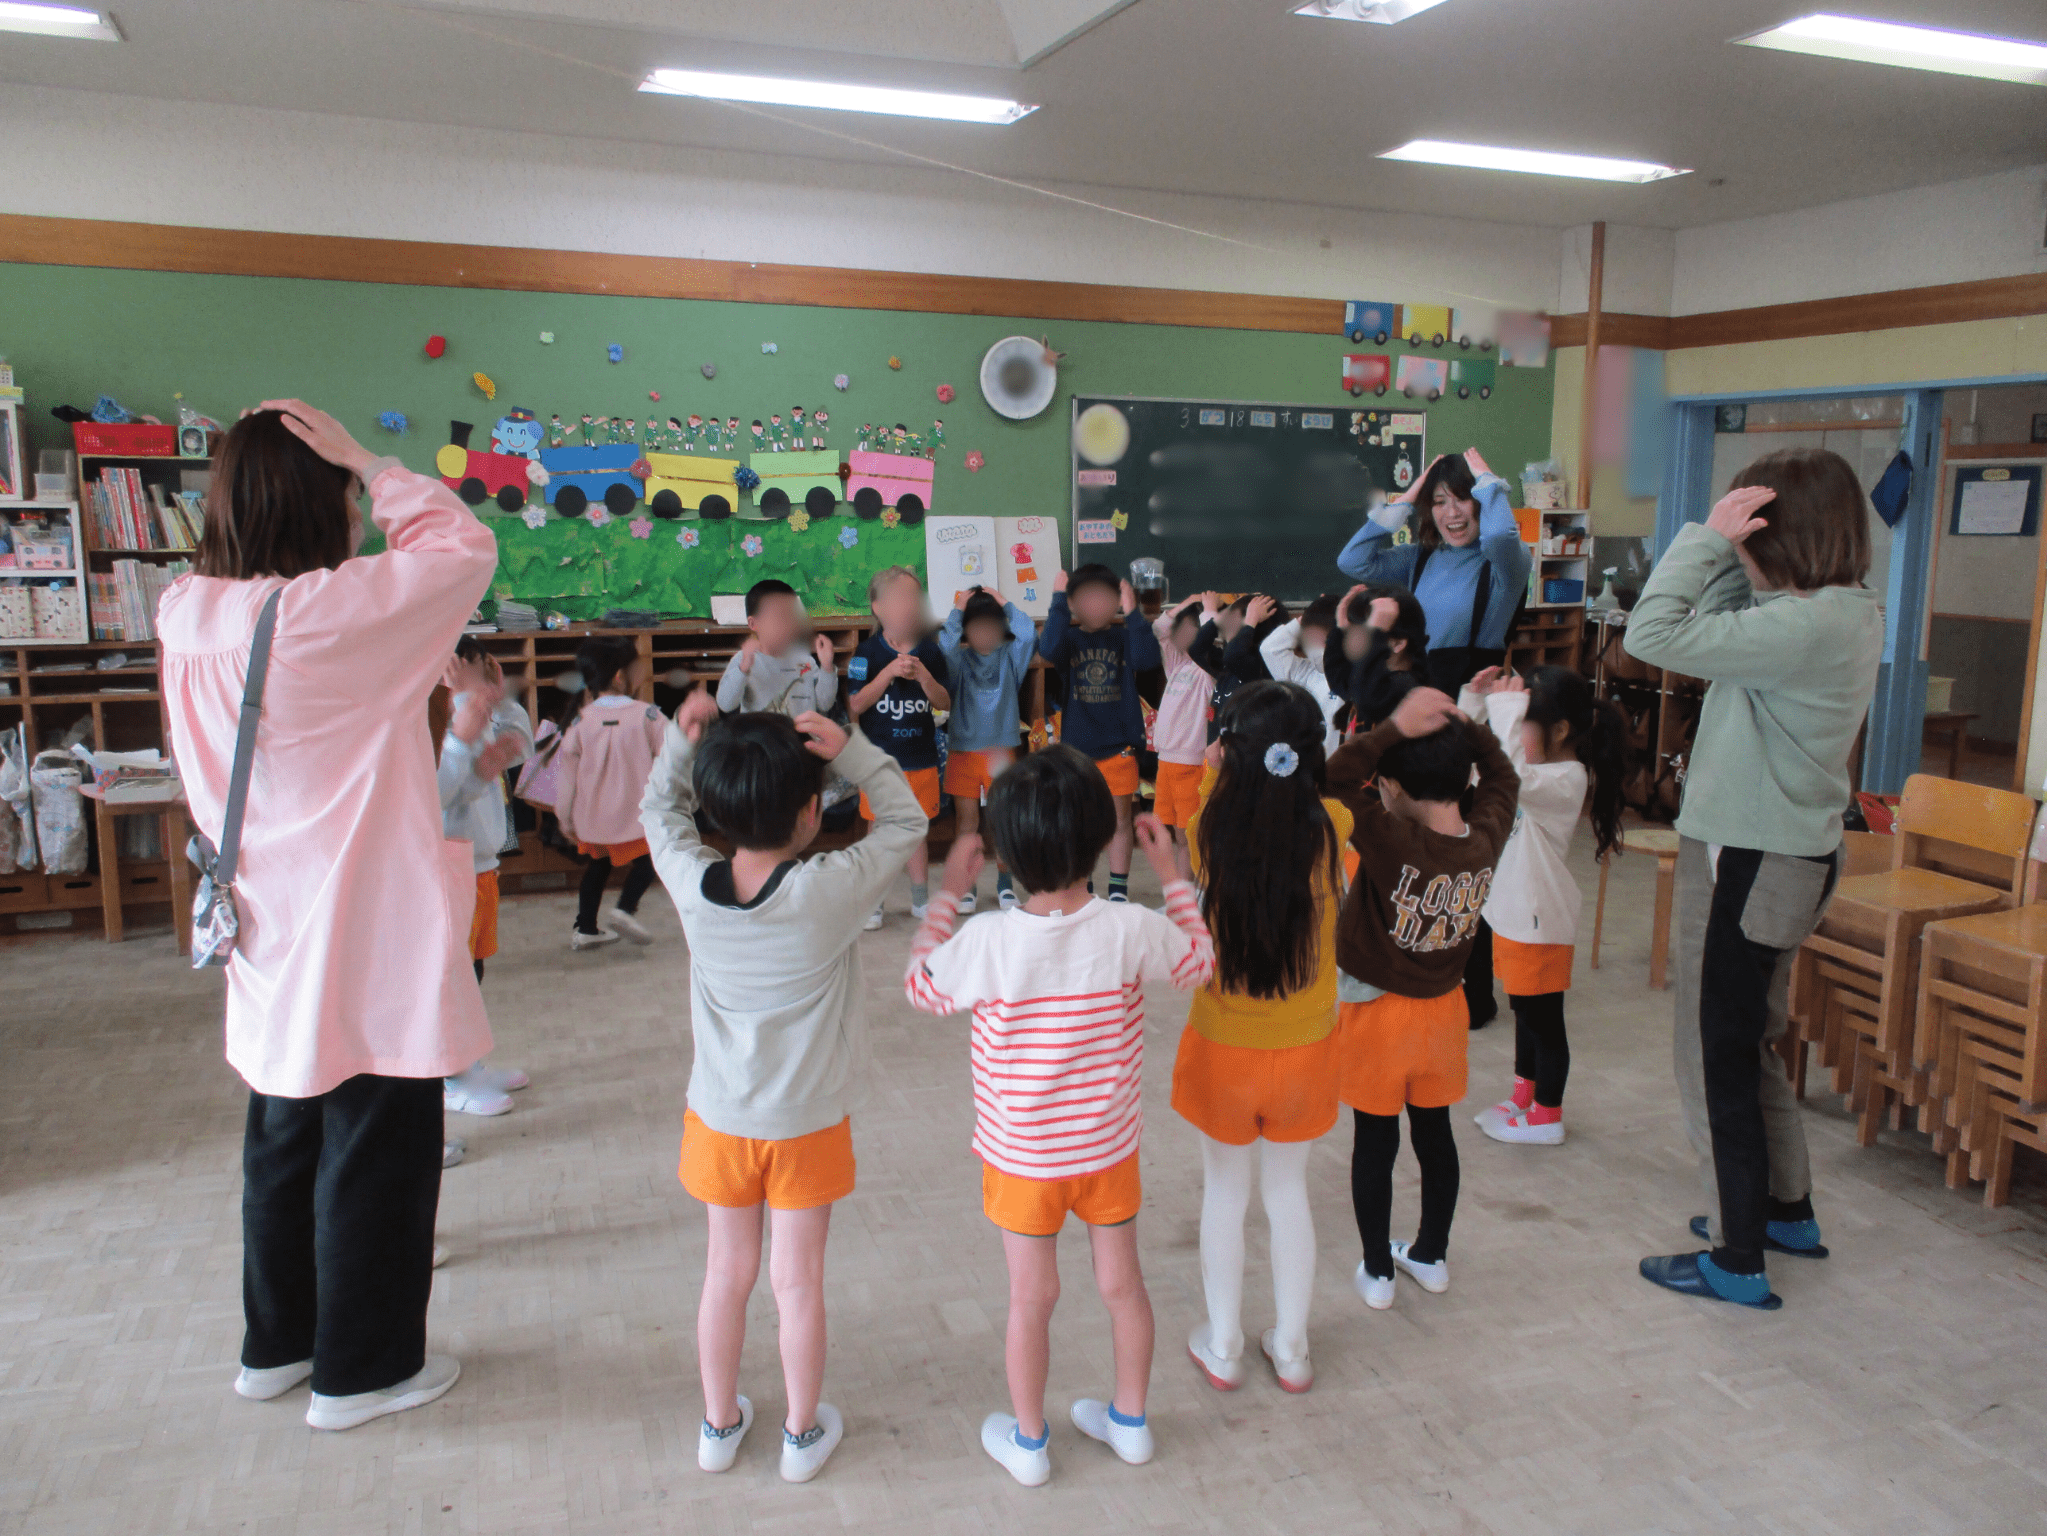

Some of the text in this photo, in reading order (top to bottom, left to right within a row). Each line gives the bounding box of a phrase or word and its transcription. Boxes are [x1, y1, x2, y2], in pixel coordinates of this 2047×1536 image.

[1180, 407, 1189, 428] 3
[1201, 410, 1224, 423] がつ
[1230, 410, 1245, 427] 18
[1252, 412, 1273, 425] にち
[1400, 467, 1409, 481] A
